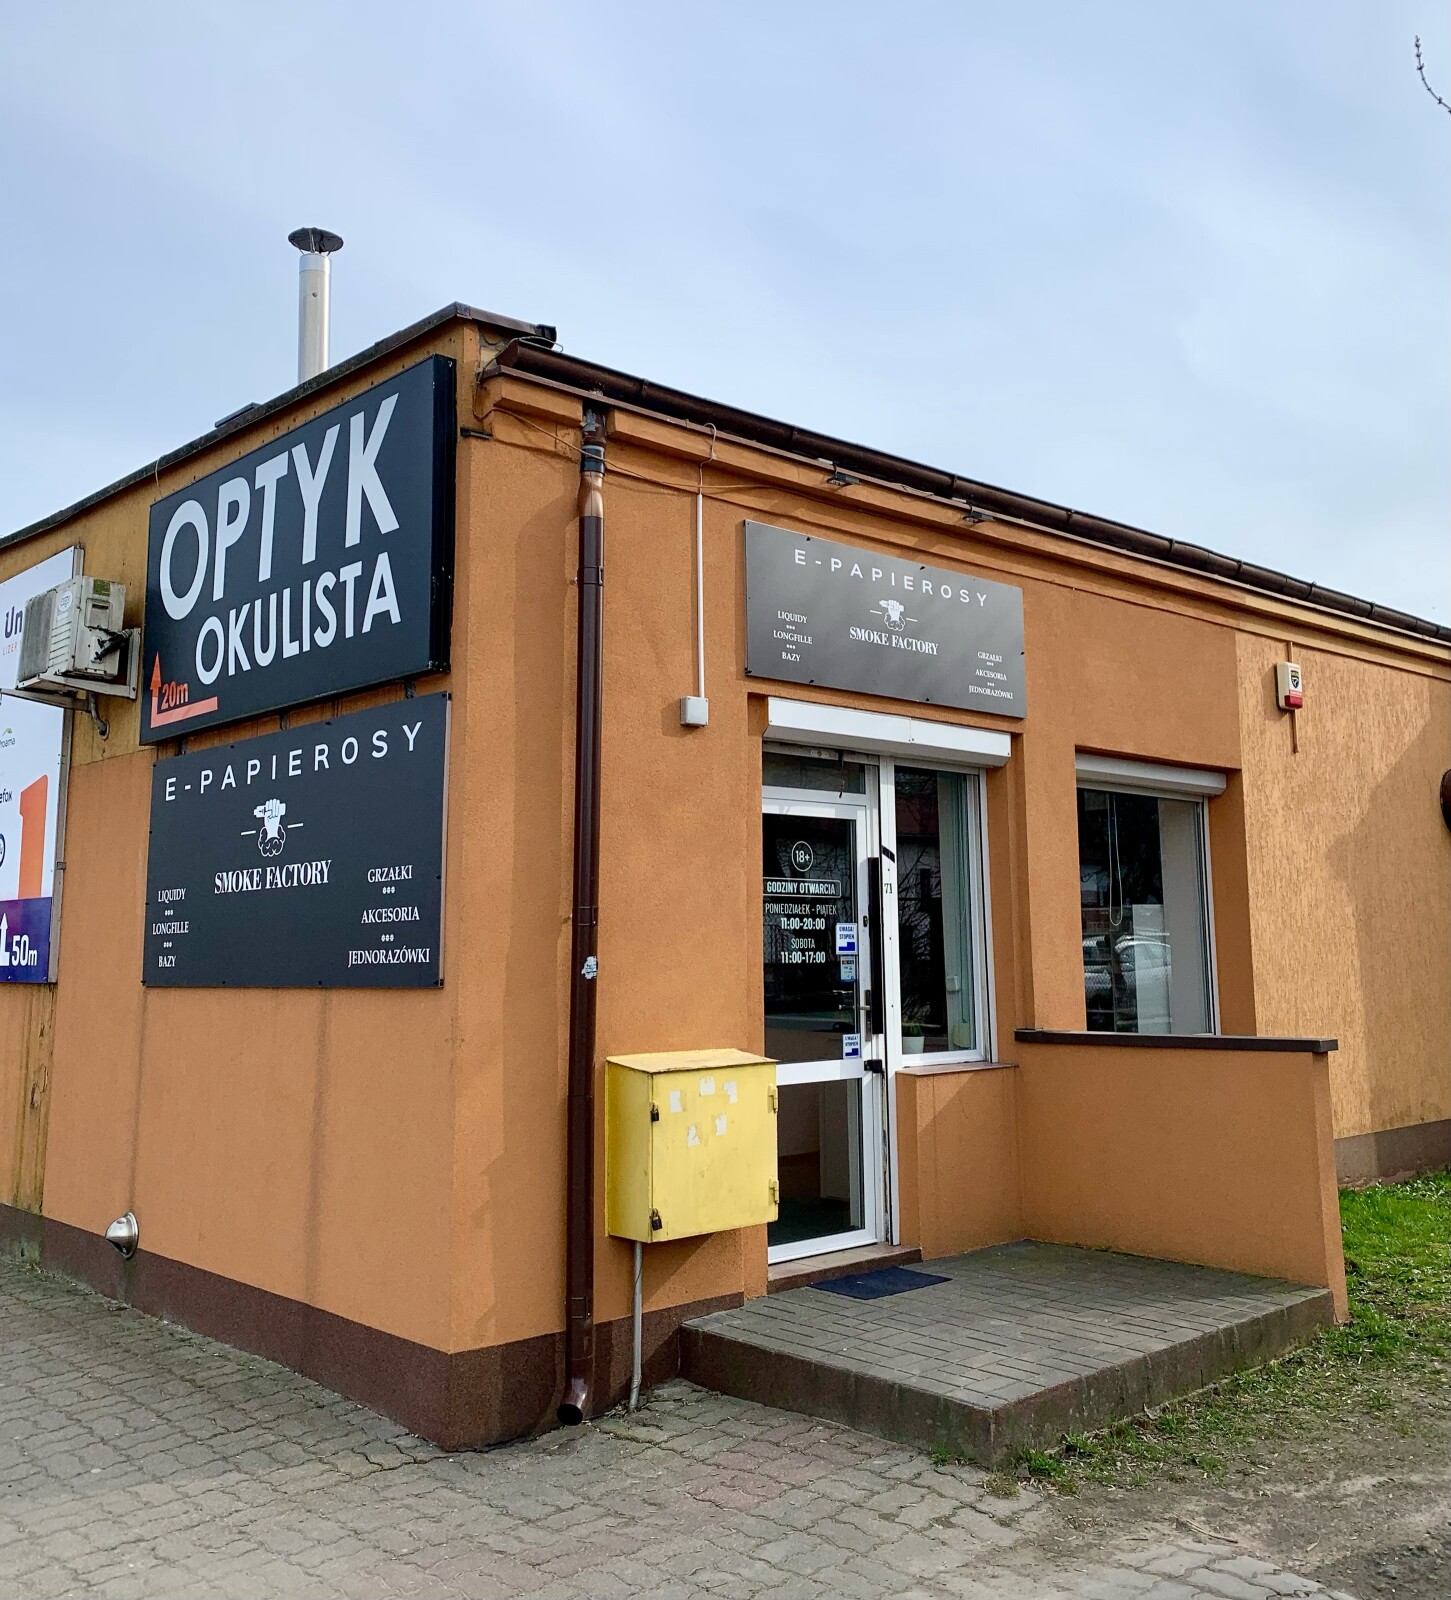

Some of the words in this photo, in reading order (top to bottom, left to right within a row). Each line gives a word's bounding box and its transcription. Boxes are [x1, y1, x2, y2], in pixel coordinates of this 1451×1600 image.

[159, 392, 400, 620] OPTYK
[793, 549, 987, 607] E-PAPIEROSY
[195, 551, 401, 685] OKULISTA
[777, 610, 808, 624] LIQUIDY
[773, 629, 813, 645] LONGFILLE
[849, 626, 890, 647] SMOKE
[892, 630, 939, 655] FACTORY
[781, 651, 801, 662] BAZY
[977, 651, 1003, 663] GRZAŁKI
[975, 668, 1008, 681] AKCESORIA
[161, 681, 189, 711] 20m
[968, 684, 1014, 700] JEDNORAZÓWKI
[165, 721, 423, 802] E-PAPIEROSY
[795, 850, 811, 863] 18+
[214, 868, 262, 895] SMOKE
[264, 860, 332, 890] FACTORY
[367, 864, 413, 883] GRZAŁKI
[158, 887, 187, 904] LIQUIDY
[766, 881, 798, 893] GODZINY
[799, 882, 836, 895] OTWARCIA
[884, 882, 893, 894] 71
[361, 906, 420, 924] AKCESORIA
[765, 902, 811, 915] PONIEDZIAŁEK
[816, 904, 838, 917] PIĄTEK
[152, 921, 190, 936] LONGFILLE
[780, 917, 826, 930] 11:00-20:00
[12, 934, 38, 967] 50m
[791, 938, 816, 949] SOBOTA
[158, 955, 177, 968] BAZY
[348, 945, 431, 968] JEDNORAZÓWKI
[780, 951, 826, 964] 11:00-17:00
